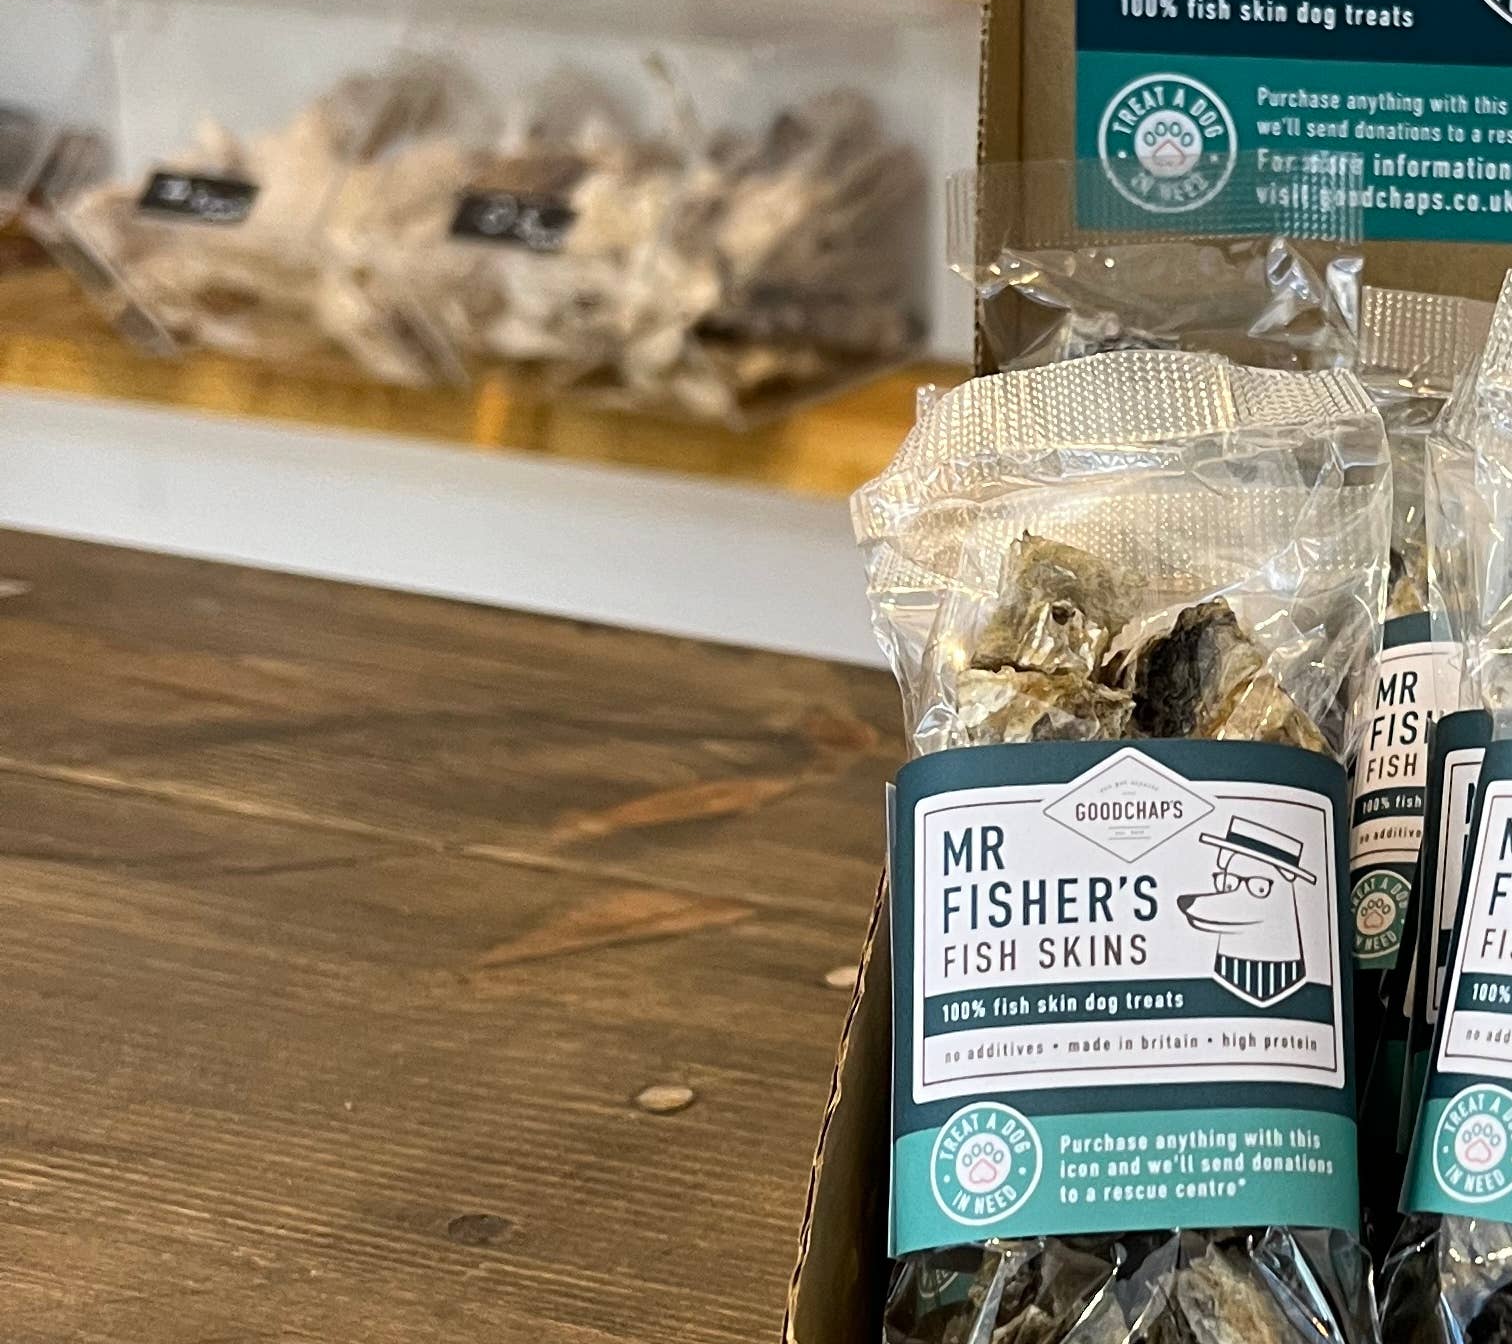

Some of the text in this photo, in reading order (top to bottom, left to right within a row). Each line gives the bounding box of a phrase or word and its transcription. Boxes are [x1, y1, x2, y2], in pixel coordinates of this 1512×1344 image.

[1239, 0, 1288, 23] skin
[1297, 2, 1337, 31] dog
[1344, 4, 1416, 29] treats
[1111, 86, 1224, 138] TREAT A DOG
[1257, 86, 1341, 109] Purchase
[1346, 91, 1424, 118] anything
[1429, 94, 1469, 114] with
[1474, 96, 1508, 116] this
[1256, 117, 1301, 137] we'll
[1306, 119, 1349, 138] send
[1354, 120, 1442, 142] donations
[1447, 123, 1466, 144] to
[1471, 127, 1483, 144] a
[1257, 148, 1297, 174] For
[1373, 153, 1512, 181] information
[1376, 671, 1418, 710] MR
[1366, 752, 1417, 783] FISH
[1362, 794, 1422, 814] 100% fish
[943, 825, 1005, 876] MR
[1379, 877, 1389, 890] A
[943, 875, 1159, 934] FISHER'S
[1364, 929, 1398, 952] NEED
[943, 934, 1148, 979] FISH SKINS
[942, 991, 1184, 1023] 100% fish skin dog treats
[1472, 982, 1511, 1004] 100%
[944, 1032, 1319, 1064] no additives made in britain high protein
[1466, 1028, 1480, 1041] no
[1444, 1093, 1485, 1133] TREAT
[1489, 1096, 1502, 1113] A
[939, 1112, 1032, 1160] TREAT A DOG
[1060, 1128, 1321, 1154] Purchase anything with this
[1060, 1152, 1334, 1179] icon and we'll send donations
[1445, 1163, 1505, 1193] IN NEED
[952, 1185, 1017, 1215] IN NEED
[1060, 1185, 1079, 1203] to
[1085, 1187, 1096, 1202] a
[1103, 1182, 1168, 1201] rescue
